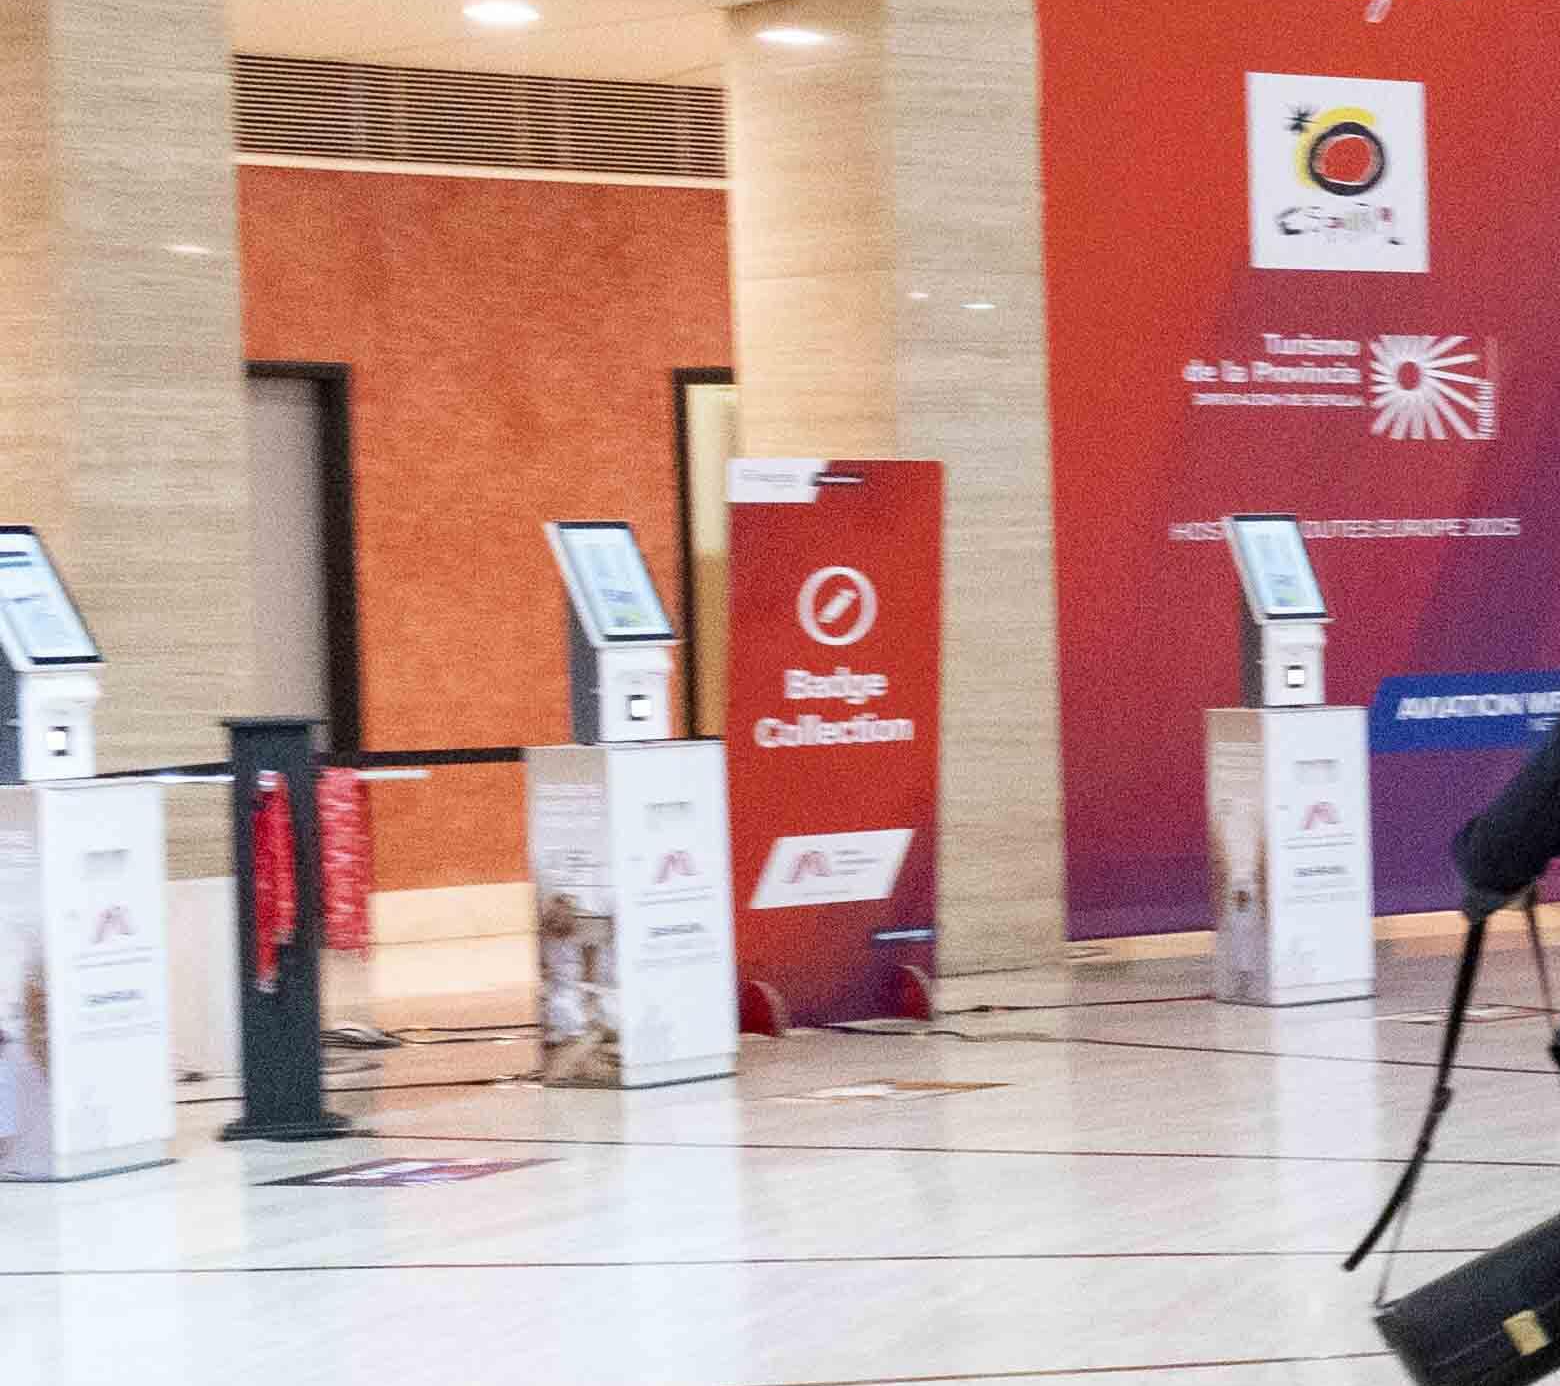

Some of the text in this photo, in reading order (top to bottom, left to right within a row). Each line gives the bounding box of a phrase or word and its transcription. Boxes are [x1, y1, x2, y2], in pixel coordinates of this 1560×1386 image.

[1263, 333, 1361, 357] Turismo
[1184, 359, 1361, 384] de la Provincia
[784, 666, 888, 705] Badge
[1396, 692, 1526, 721] AVIATION
[754, 713, 914, 748] Collection
